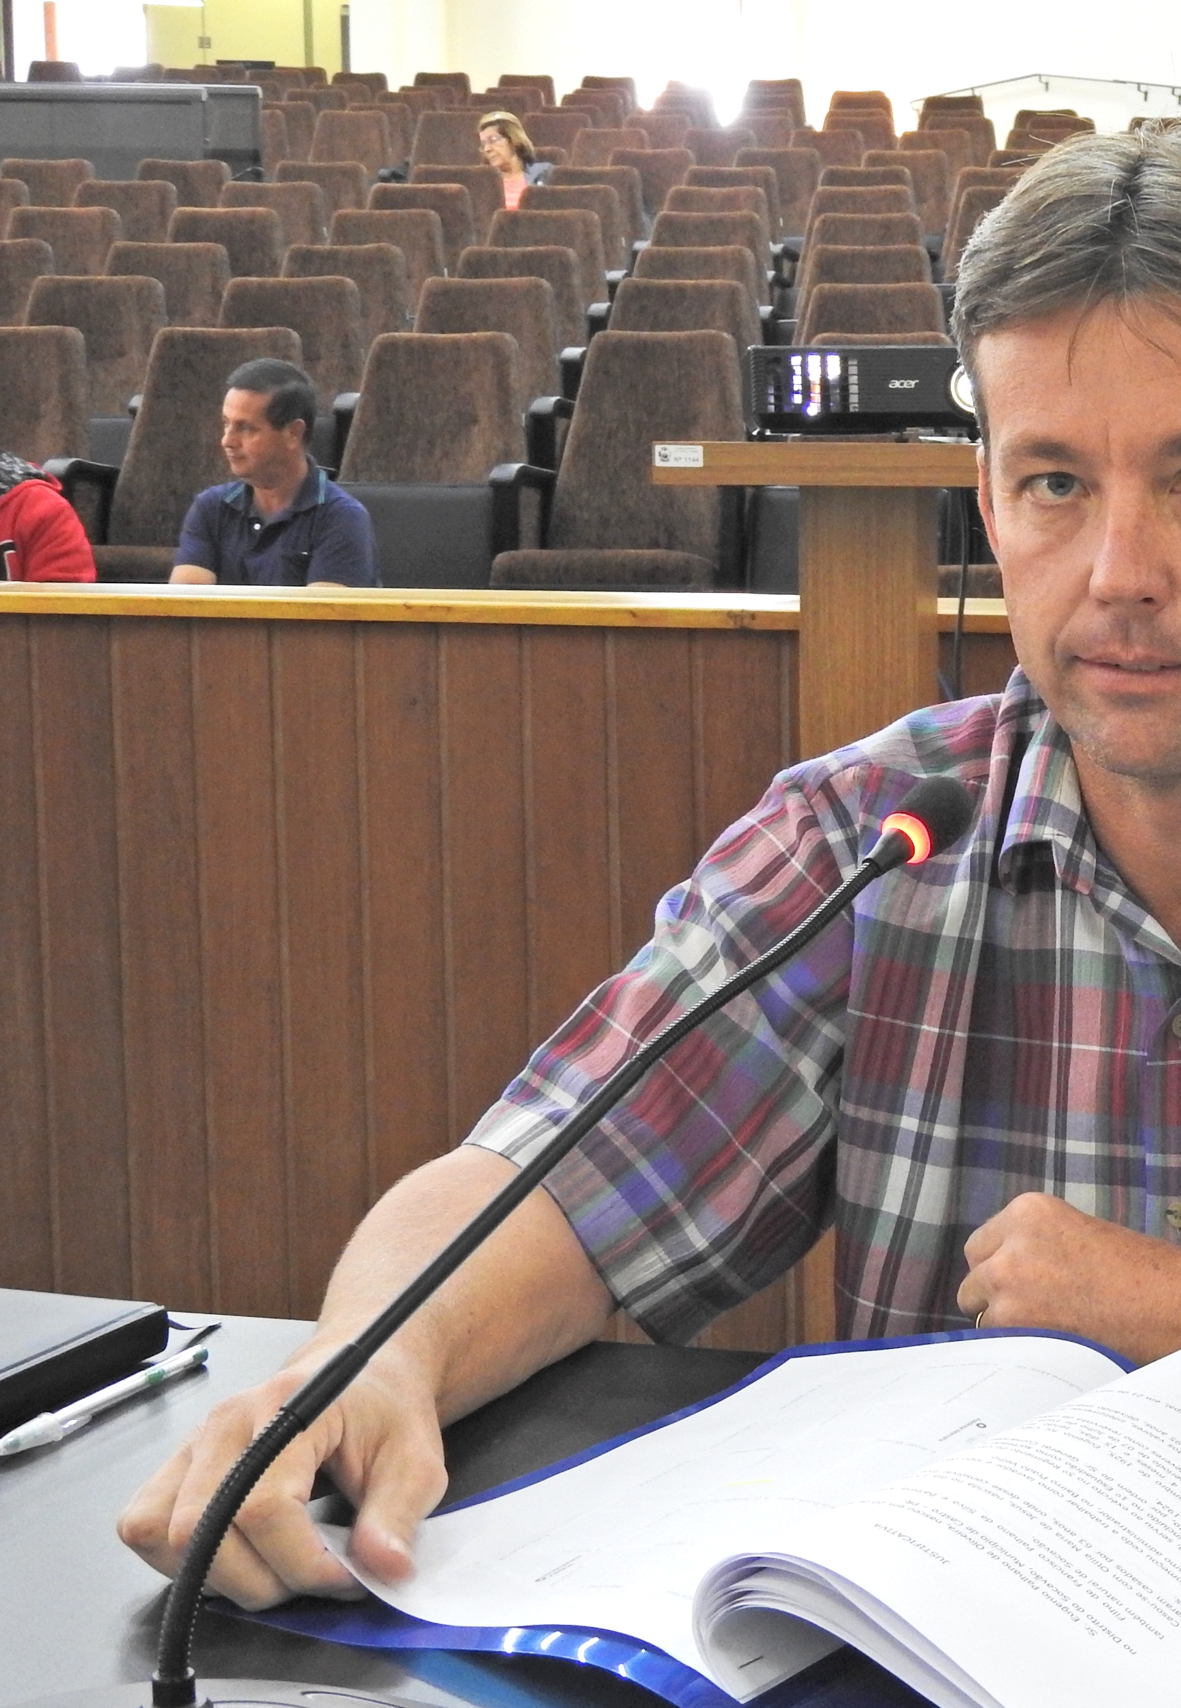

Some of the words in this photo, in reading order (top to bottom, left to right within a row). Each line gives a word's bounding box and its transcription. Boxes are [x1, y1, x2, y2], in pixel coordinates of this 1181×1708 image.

[889, 379, 919, 389] acer
[1123, 1435, 1149, 1450] como
[1136, 1451, 1150, 1459] de
[1135, 1458, 1166, 1478] meses
[1136, 1469, 1151, 1478] de
[1075, 1476, 1090, 1485] no
[1100, 1473, 1114, 1481] do
[1036, 1481, 1065, 1498] como
[1116, 1483, 1148, 1503] ordem
[1021, 1500, 1048, 1516] onde
[1079, 1498, 1094, 1507] no
[1130, 1502, 1144, 1511] no
[1065, 1498, 1110, 1528] trabalhar
[1129, 1511, 1143, 1520] ao
[1149, 1505, 1168, 1517] por
[979, 1514, 994, 1523] da
[1038, 1521, 1053, 1530] de
[964, 1525, 979, 1534] de
[1143, 1521, 1173, 1543] serviu
[995, 1524, 1035, 1551] Palhano
[1054, 1532, 1082, 1552] Maria
[1077, 1538, 1093, 1548] 63
[1119, 1535, 1144, 1553] cedo
[985, 1550, 1001, 1560] de
[1094, 1549, 1114, 1563] por
[1000, 1561, 1040, 1590] Palhano
[1037, 1553, 1083, 1587] Francisco
[1073, 1568, 1088, 1578] de
[1111, 1573, 1134, 1590] com
[1114, 1564, 1153, 1594] casados
[1084, 1589, 1099, 1599] de
[1087, 1579, 1123, 1607] natural
[1040, 1590, 1081, 1622] Eugenio
[1070, 1602, 1085, 1613] do
[1101, 1601, 1126, 1621] Filho
[1134, 1591, 1180, 1627] Casou-se
[1082, 1623, 1097, 1636] Sr.
[1085, 1613, 1122, 1643] Distrito
[1122, 1643, 1137, 1655] no
